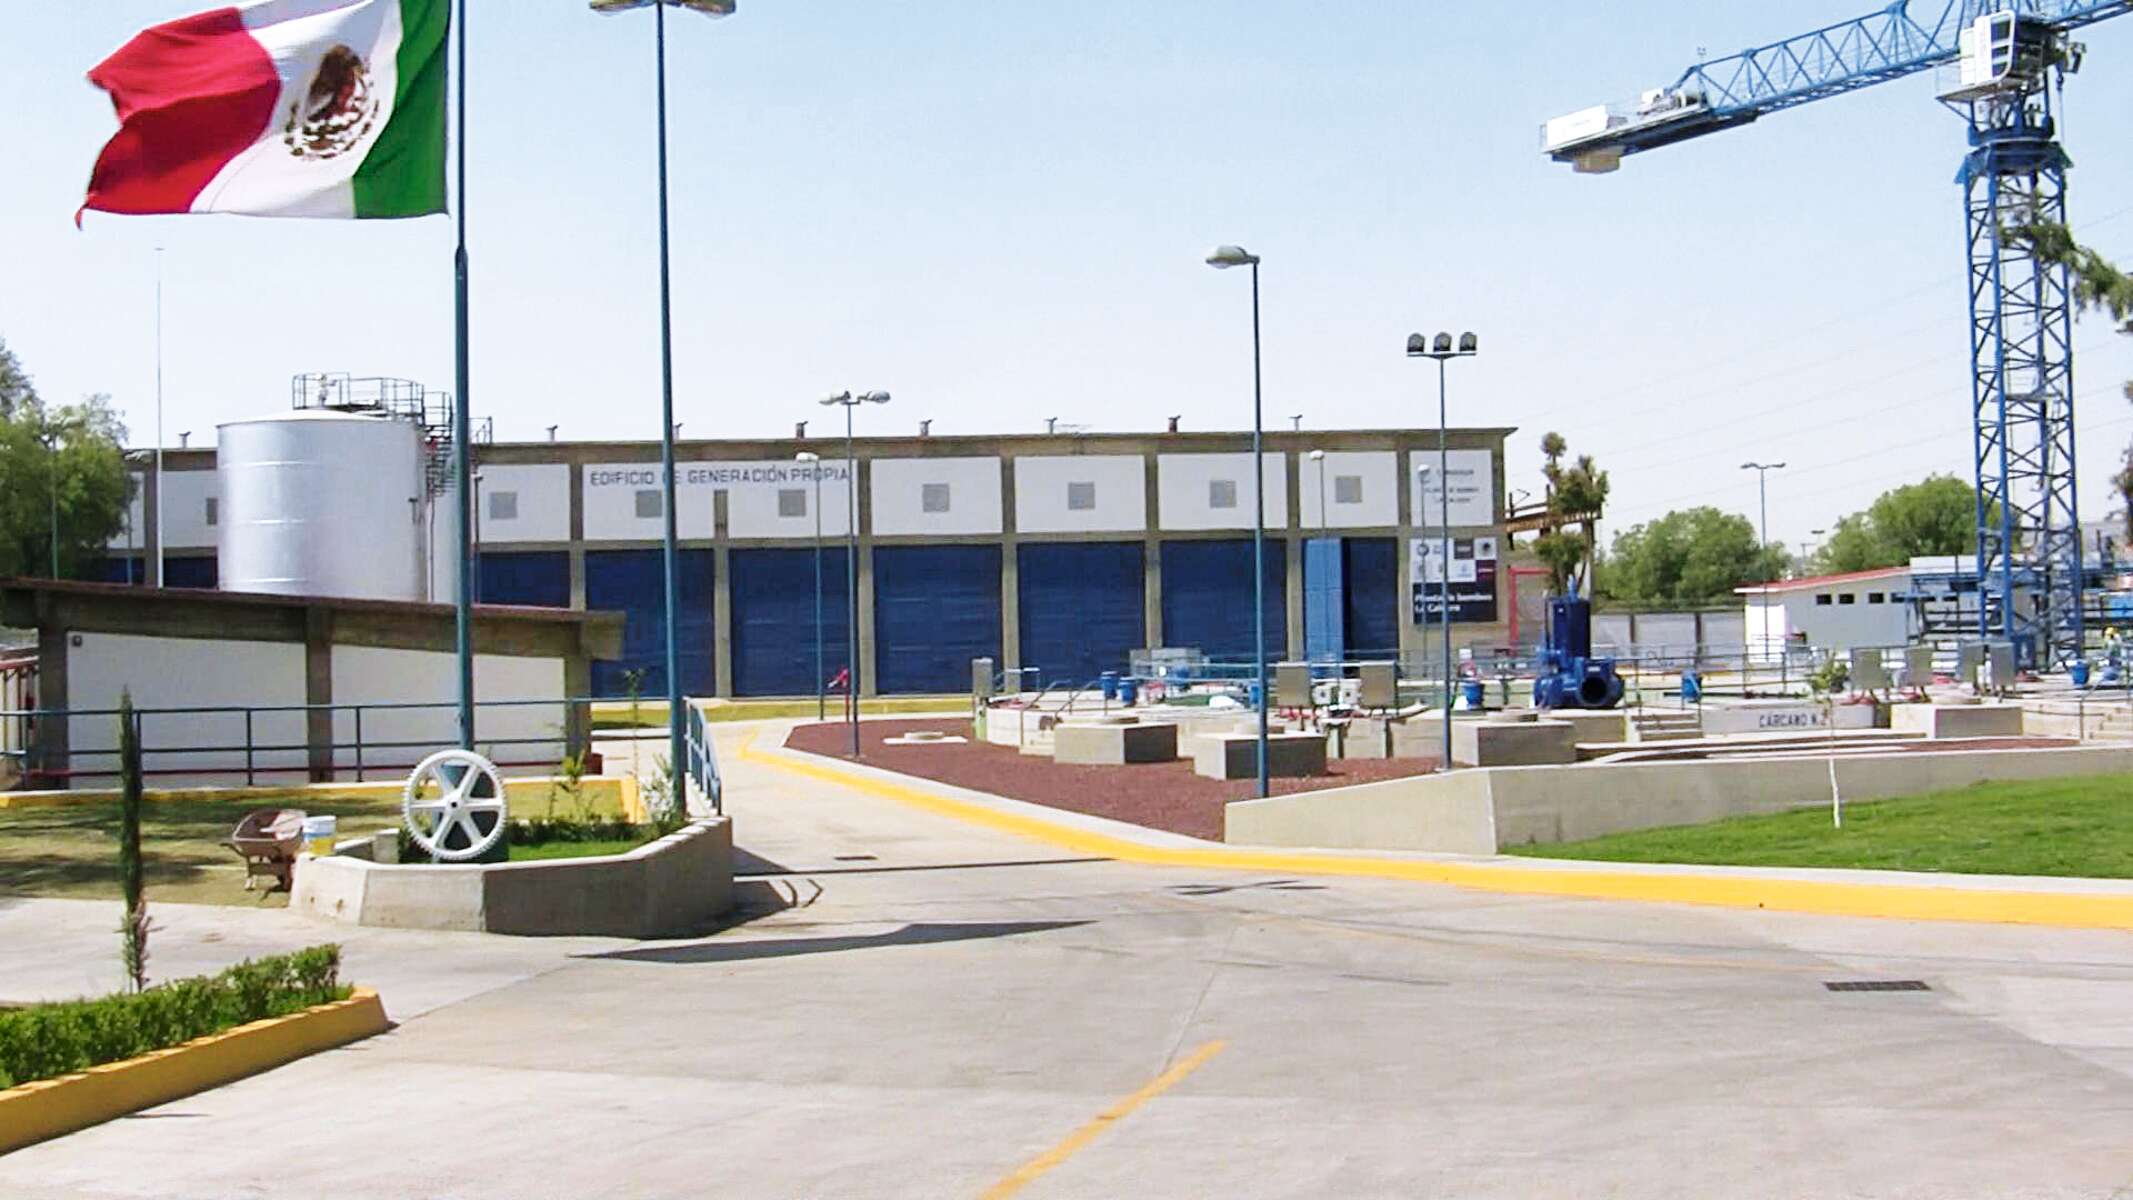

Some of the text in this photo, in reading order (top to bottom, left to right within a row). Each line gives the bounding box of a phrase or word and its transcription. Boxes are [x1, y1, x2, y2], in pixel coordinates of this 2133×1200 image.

[590, 471, 655, 486] EDIFICIO
[687, 464, 787, 484] GENERACIÓN
[791, 467, 848, 482] PROPIA
